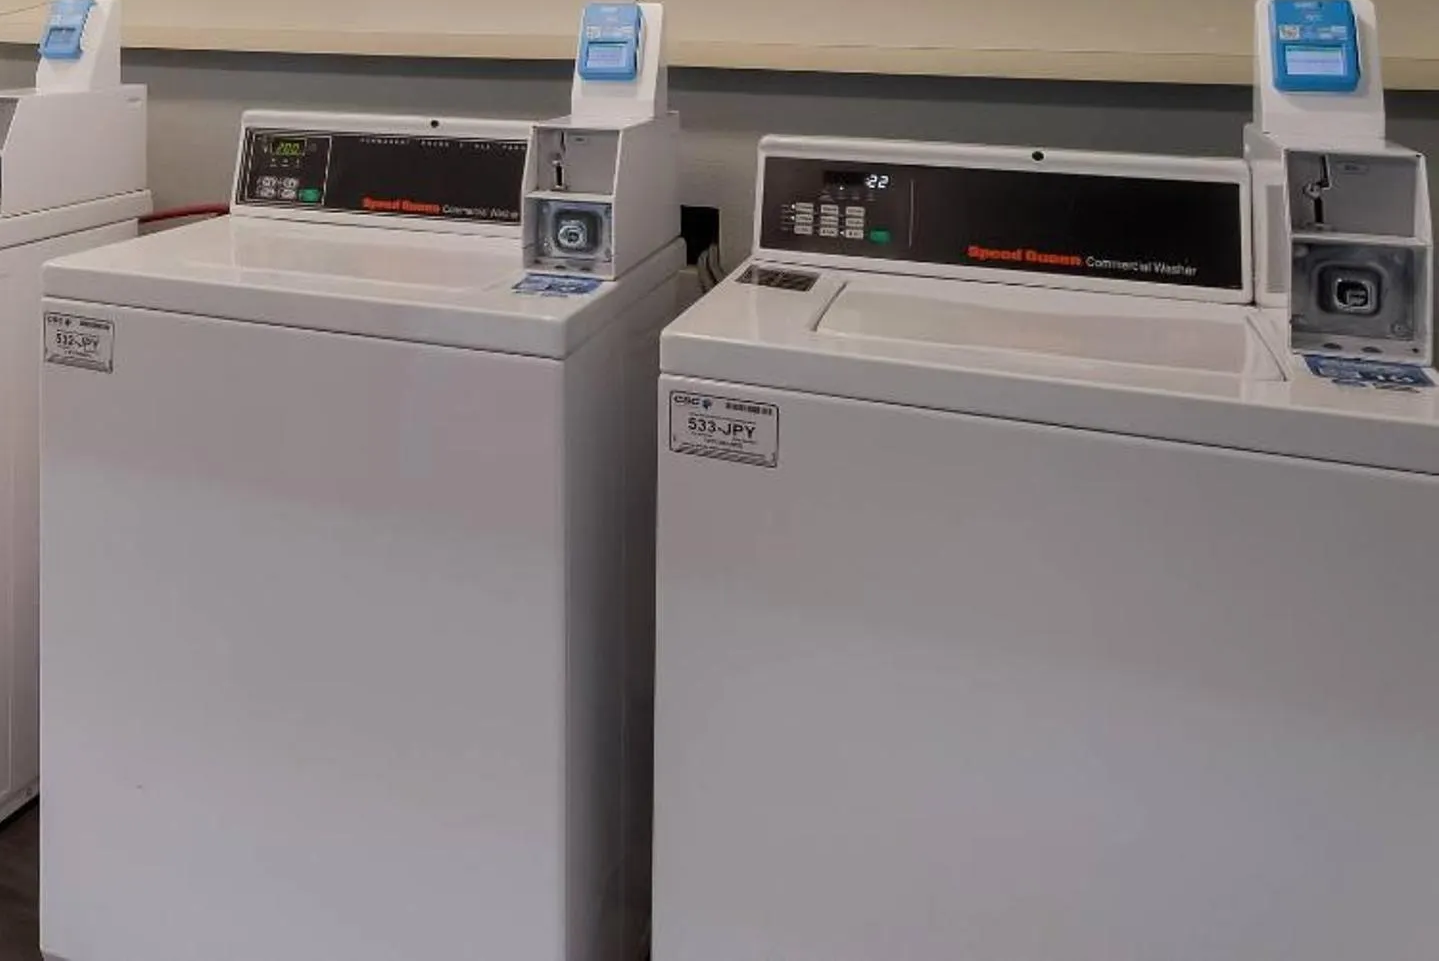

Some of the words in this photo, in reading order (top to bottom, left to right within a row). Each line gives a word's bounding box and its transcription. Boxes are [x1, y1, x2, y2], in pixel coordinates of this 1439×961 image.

[967, 245, 1023, 262] Speed
[1025, 249, 1082, 266] Queen
[1085, 256, 1151, 272] Commercial
[1153, 260, 1197, 276] Washer
[688, 417, 756, 438] 533-JPY
